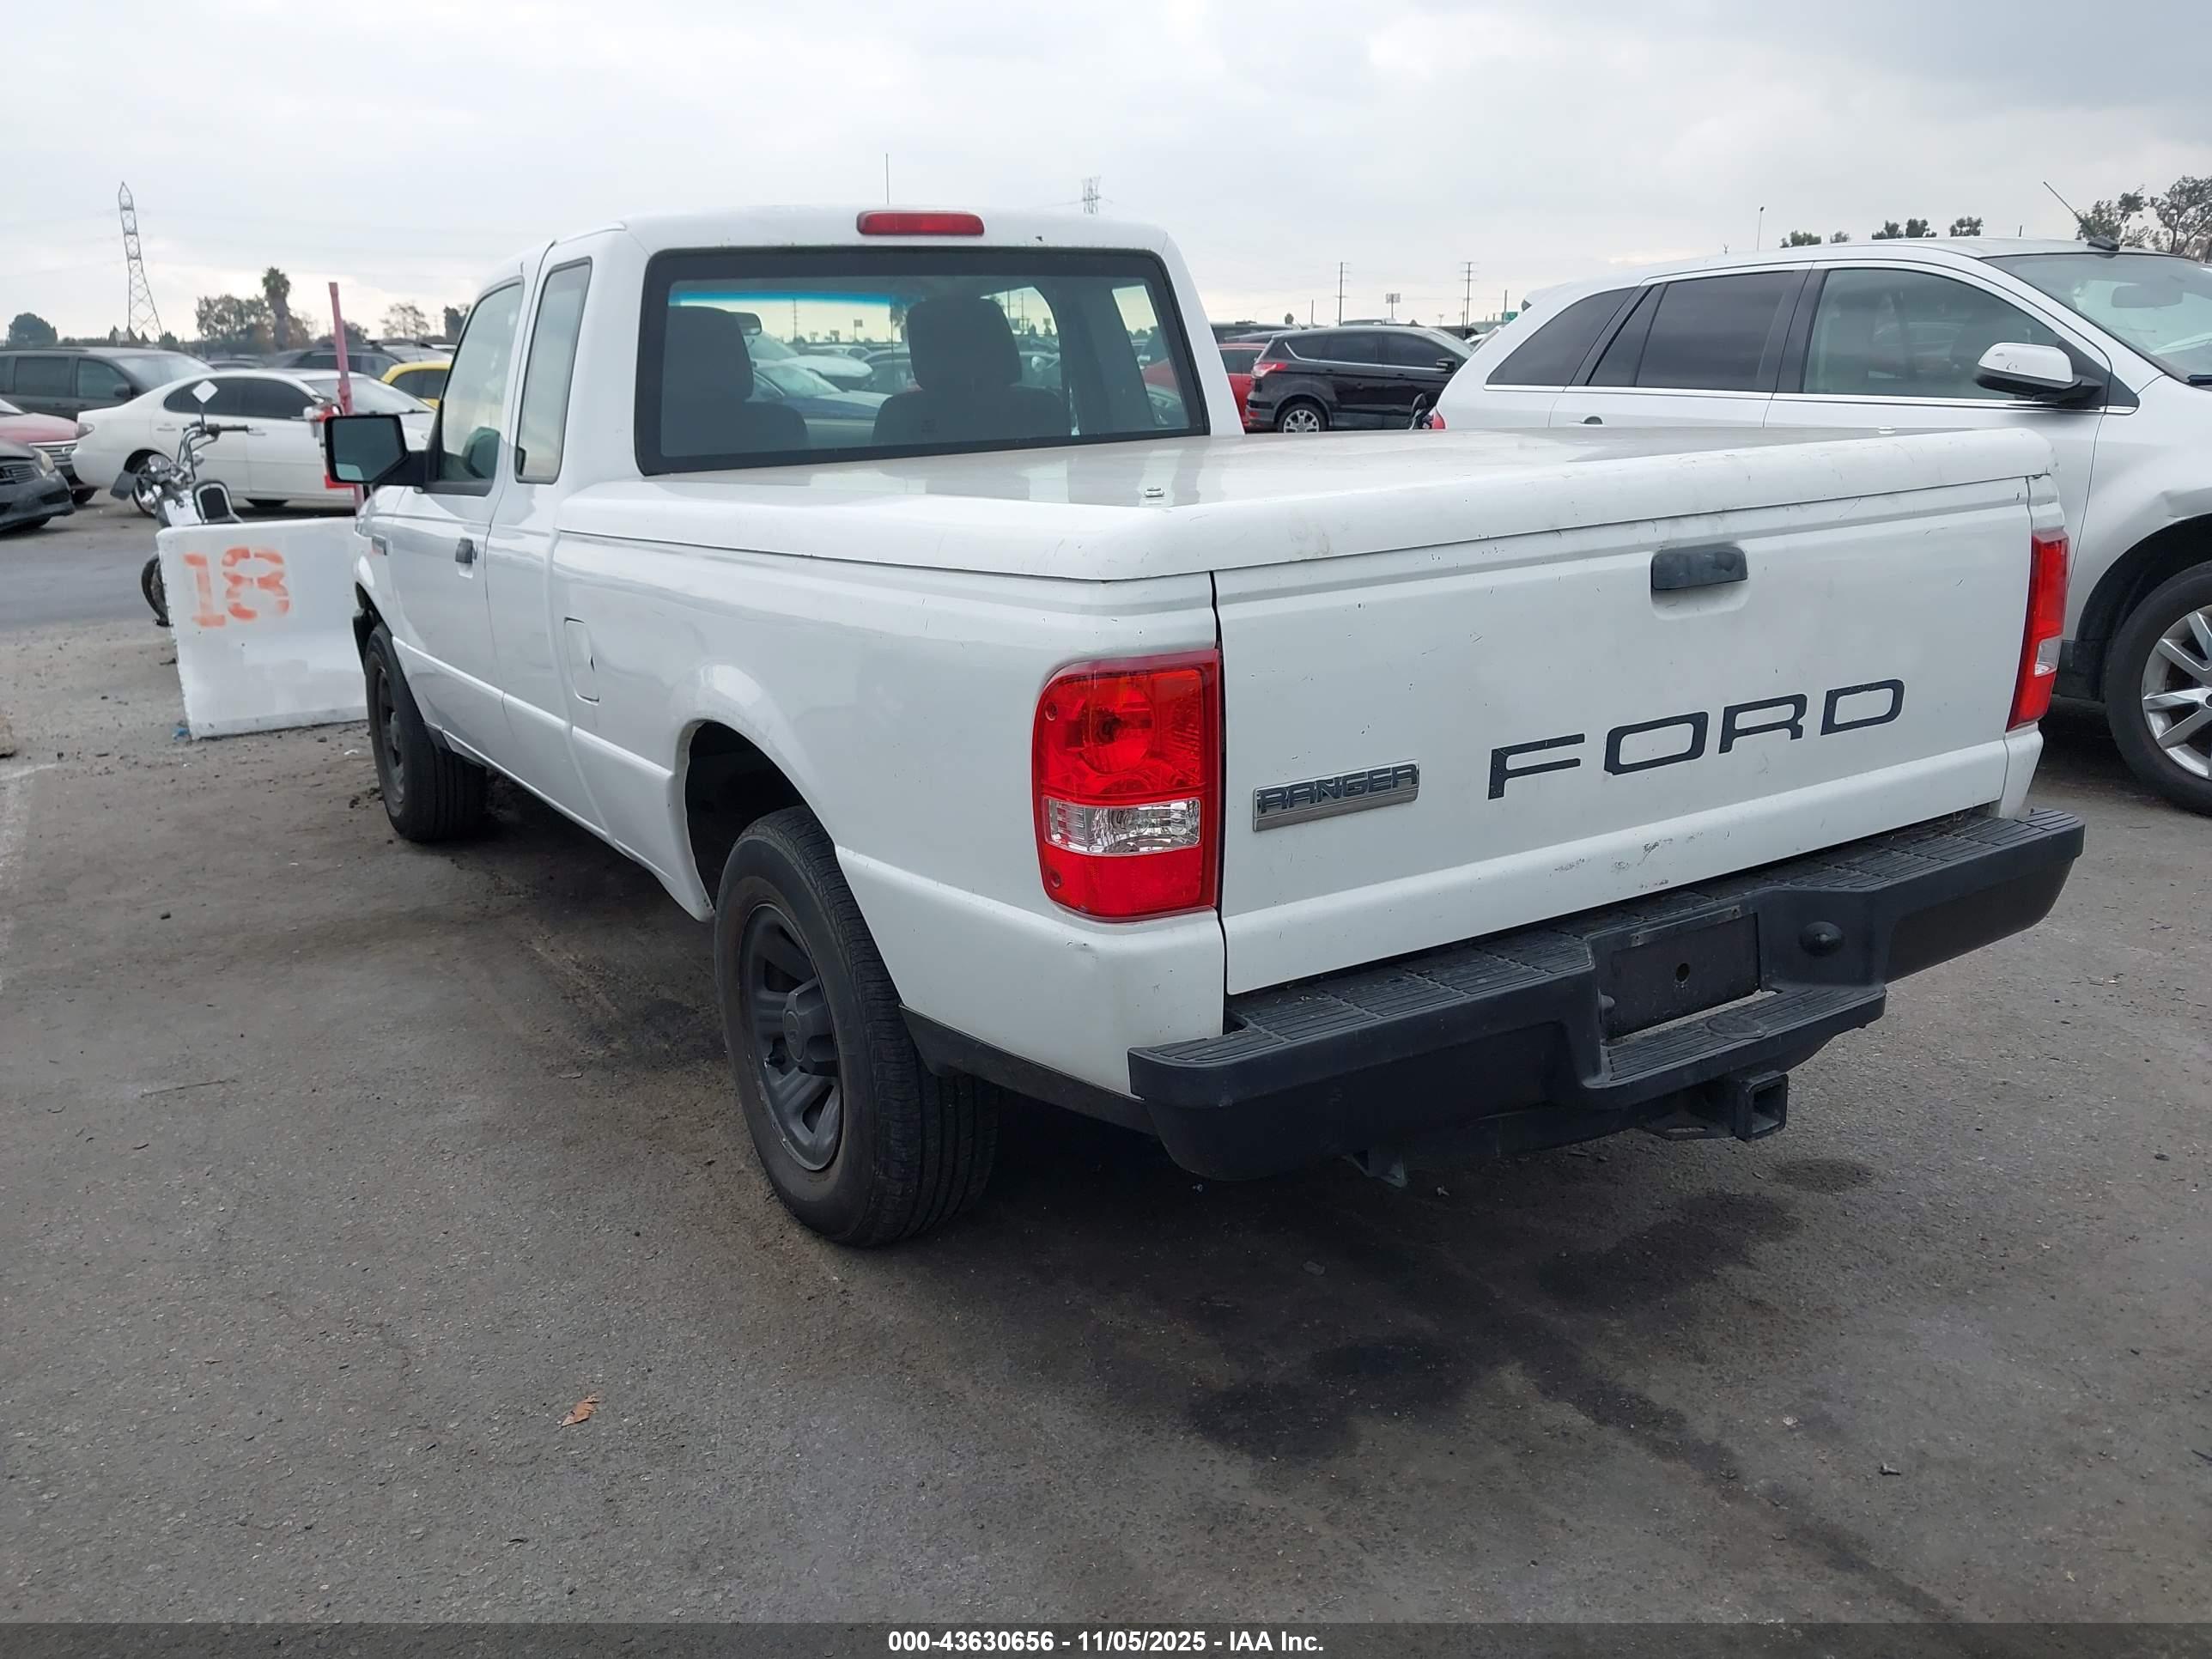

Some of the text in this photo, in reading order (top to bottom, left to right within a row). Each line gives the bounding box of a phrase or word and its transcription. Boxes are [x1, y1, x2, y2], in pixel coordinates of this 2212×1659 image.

[184, 544, 290, 629] 18
[1488, 679, 1905, 800] FORD
[1257, 763, 1419, 813] RANGER
